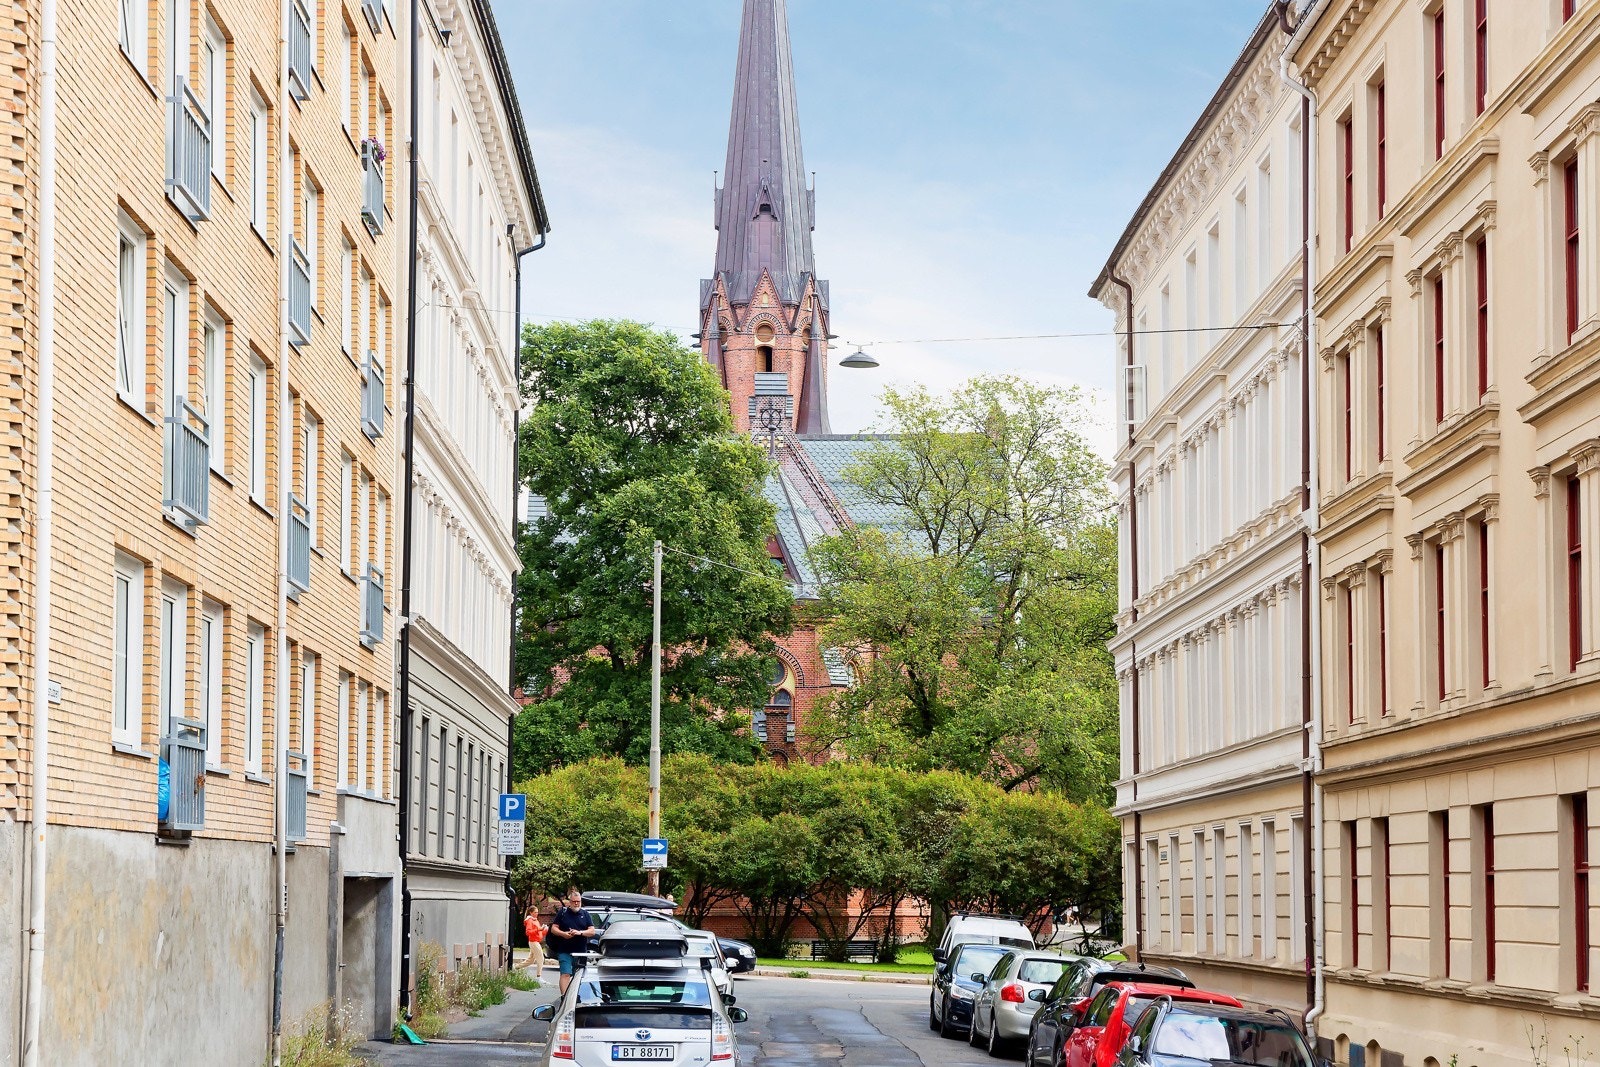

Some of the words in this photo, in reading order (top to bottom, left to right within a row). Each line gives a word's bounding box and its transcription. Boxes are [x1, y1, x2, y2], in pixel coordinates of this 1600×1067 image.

[506, 798, 520, 818] P
[623, 1048, 636, 1057] BT
[640, 1048, 669, 1057] 88171
